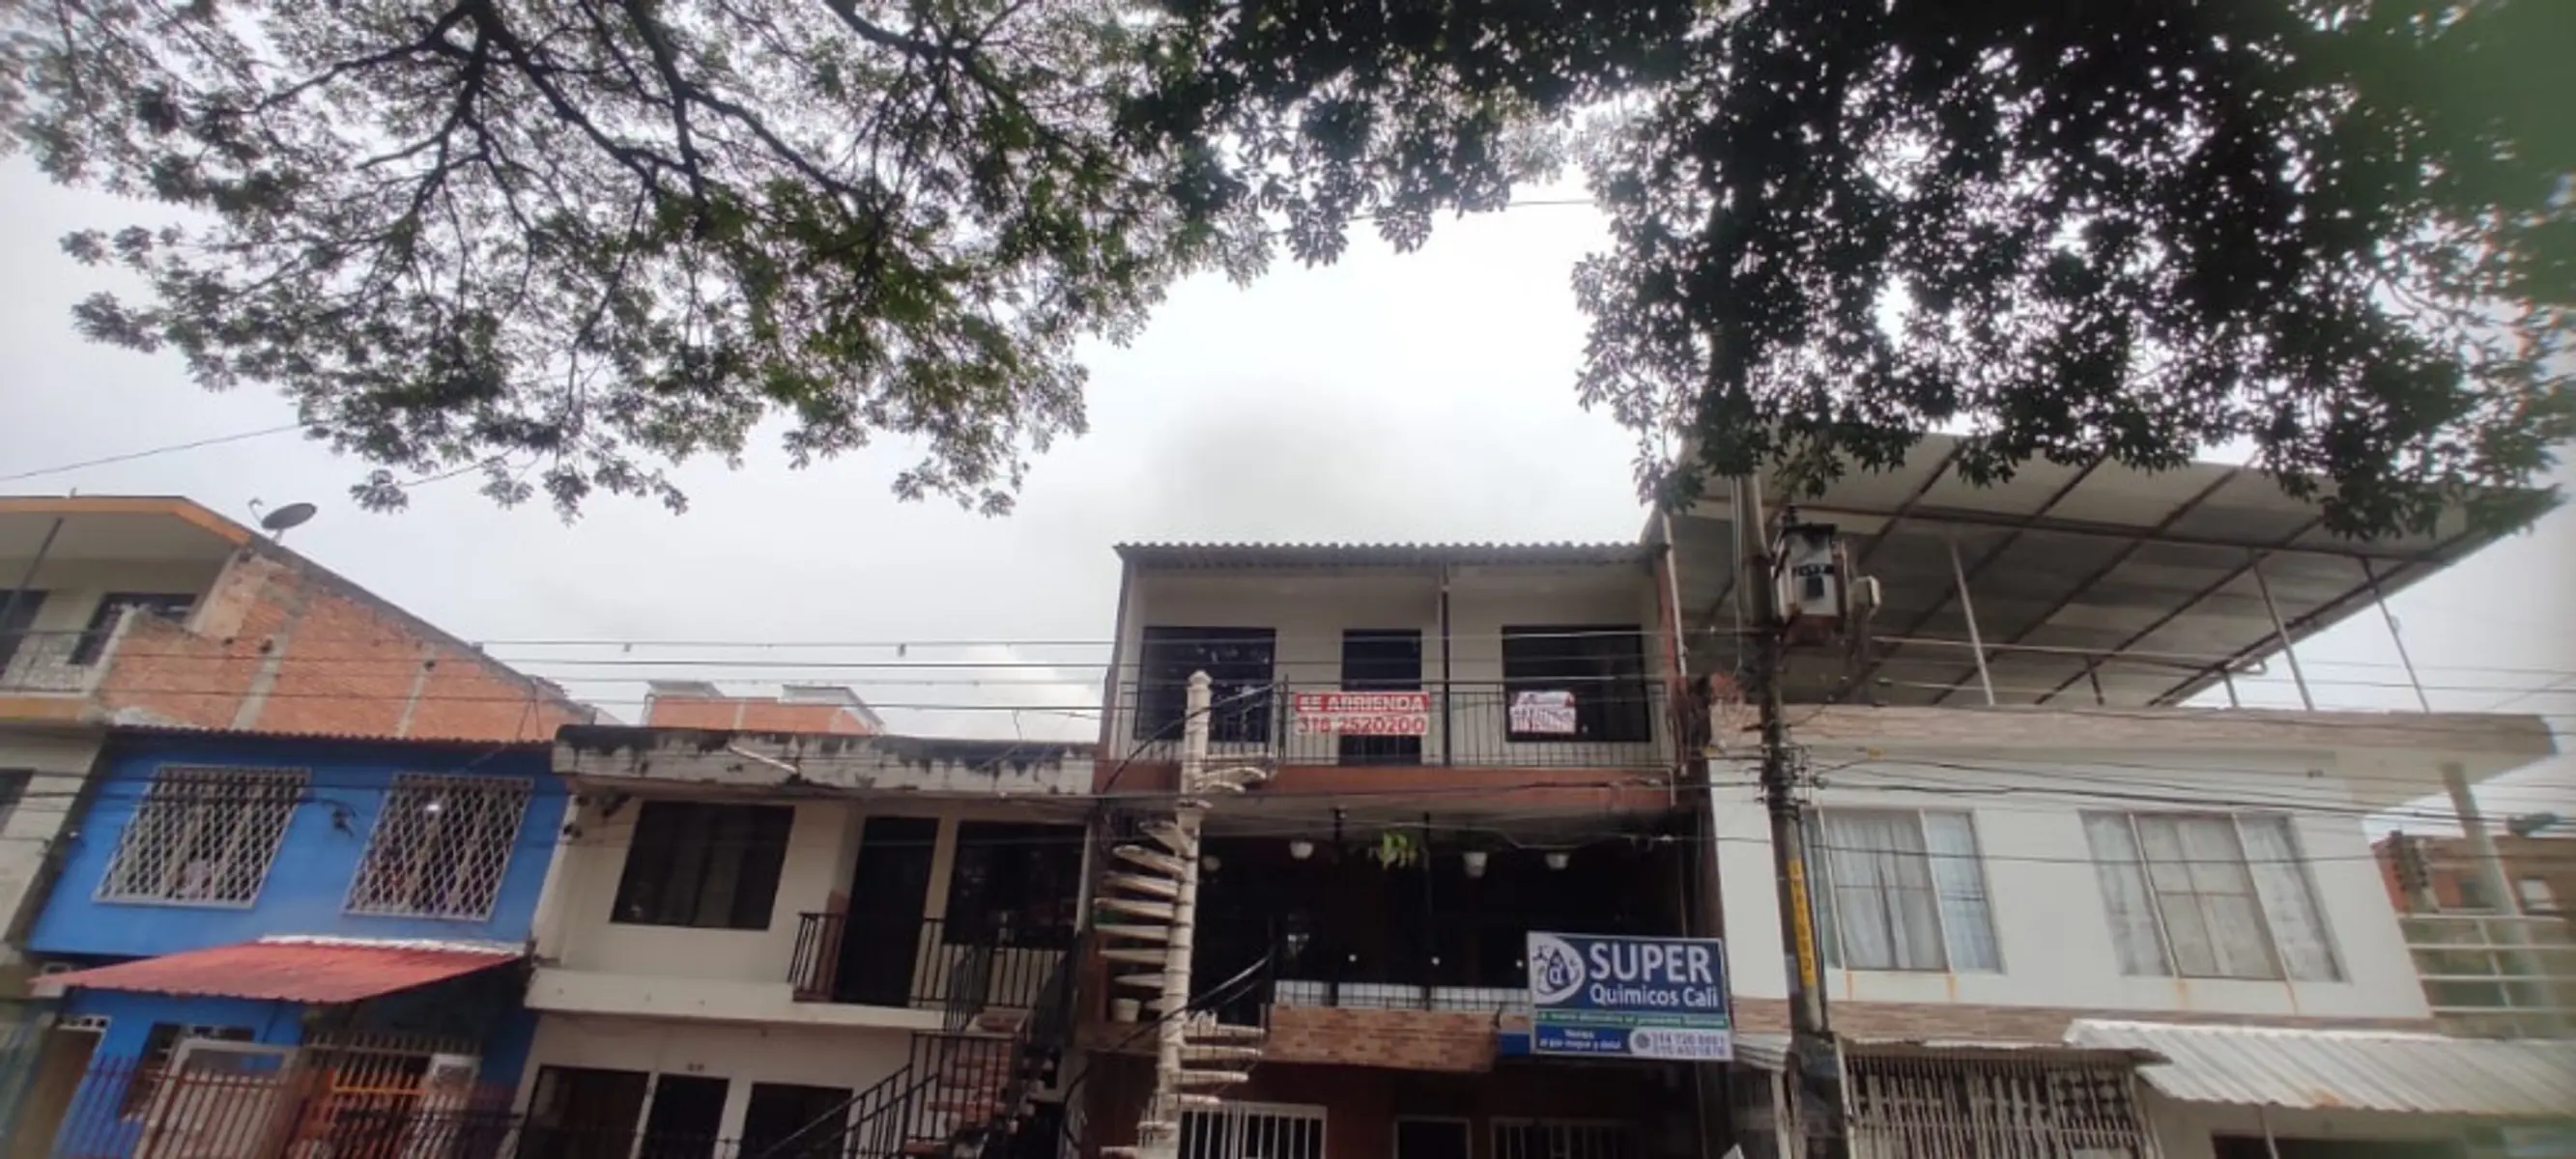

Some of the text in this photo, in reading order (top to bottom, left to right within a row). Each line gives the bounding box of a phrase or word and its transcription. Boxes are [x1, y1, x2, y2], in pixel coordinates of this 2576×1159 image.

[1300, 695, 1425, 711] SE ARRIENDA
[1338, 716, 1426, 733] 2520200
[1589, 942, 1712, 983] SUPER
[1589, 984, 1718, 1007] Quimicos Cali
